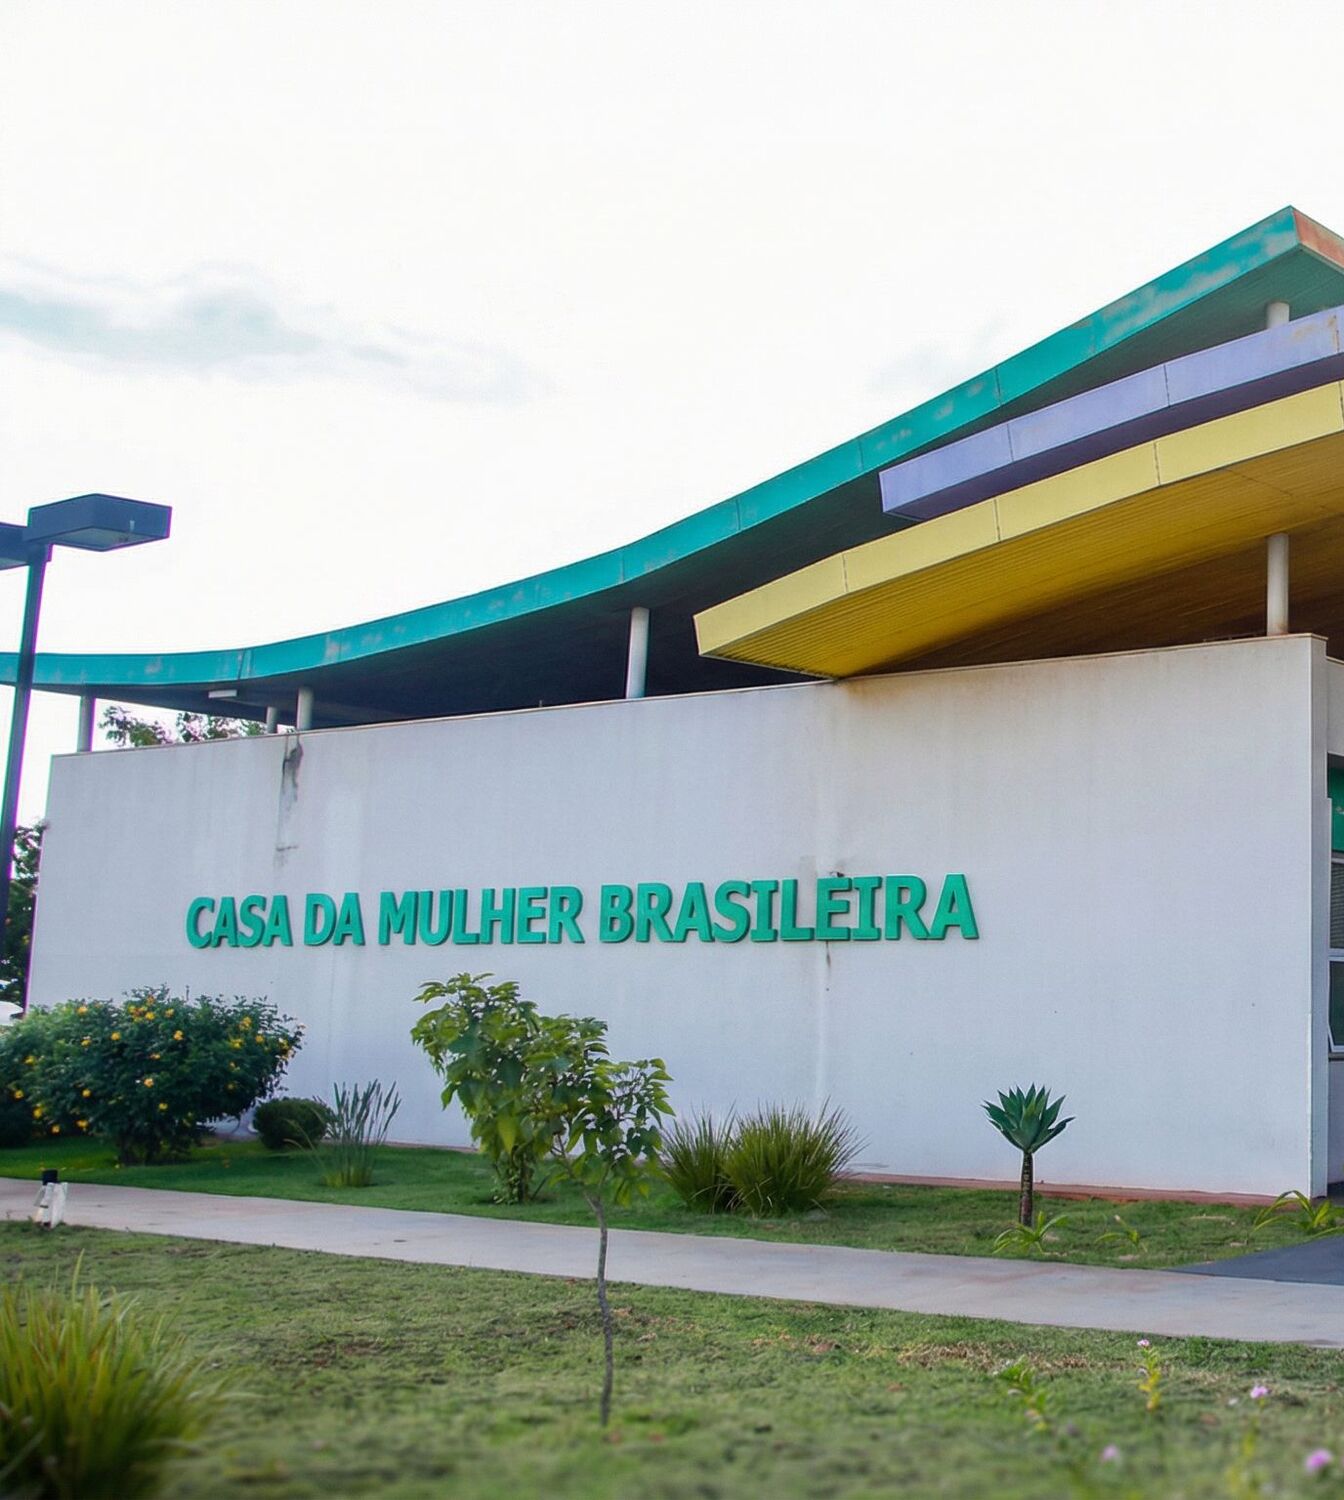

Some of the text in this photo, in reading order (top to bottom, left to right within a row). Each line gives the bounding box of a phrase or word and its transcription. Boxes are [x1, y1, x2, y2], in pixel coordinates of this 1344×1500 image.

[186, 873, 979, 949] CASA DA MULHER BRASILEIRA
